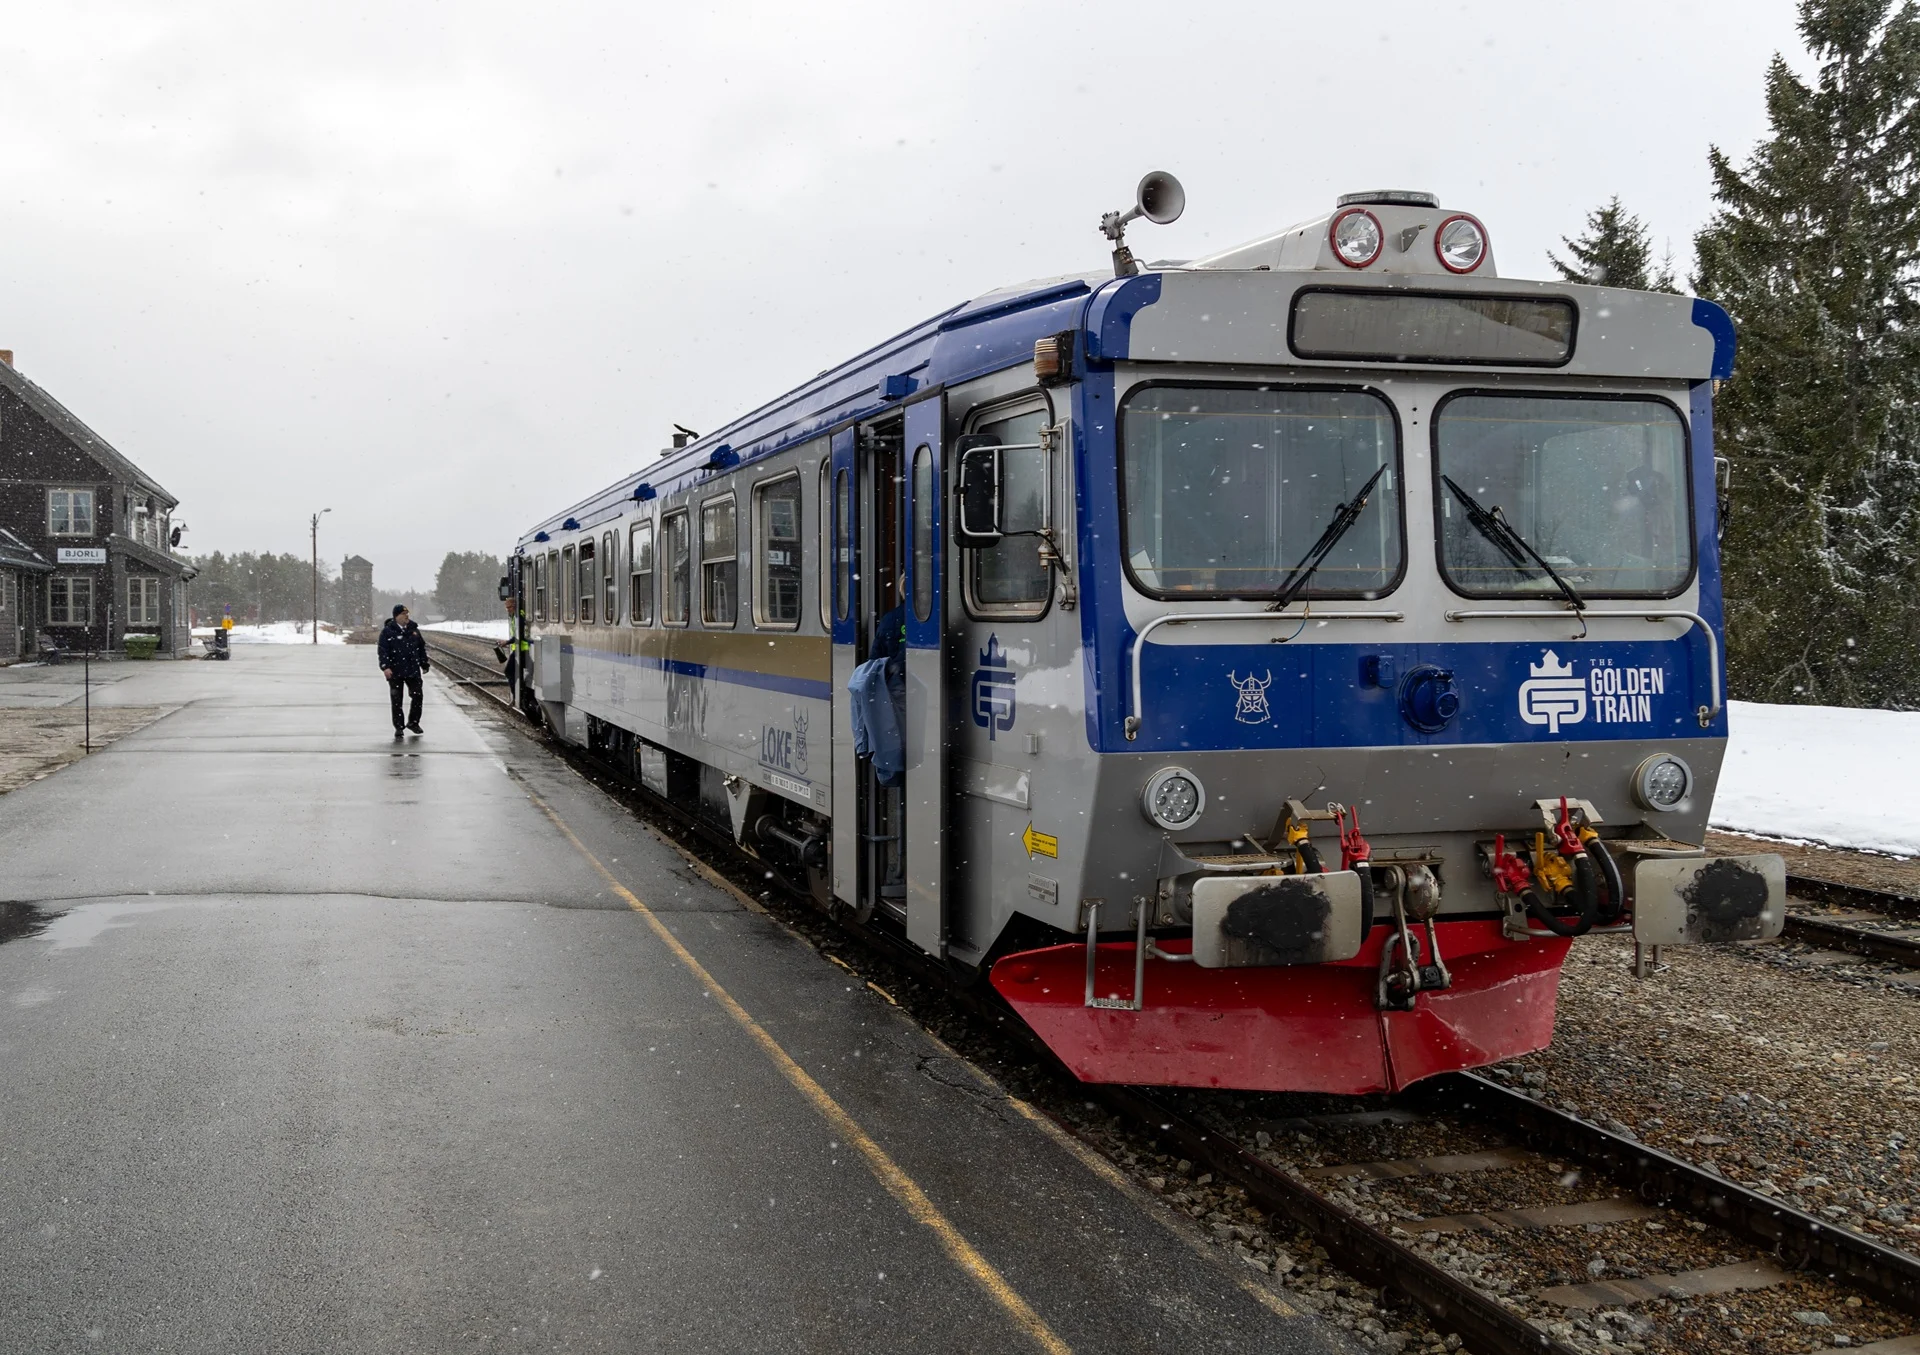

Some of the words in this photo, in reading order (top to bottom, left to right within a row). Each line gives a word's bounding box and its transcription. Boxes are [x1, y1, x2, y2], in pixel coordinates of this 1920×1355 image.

[1590, 658, 1613, 666] THE
[1590, 667, 1664, 695] GOLDEN
[1591, 695, 1651, 723] TRAIN
[761, 725, 792, 770] LOKE
